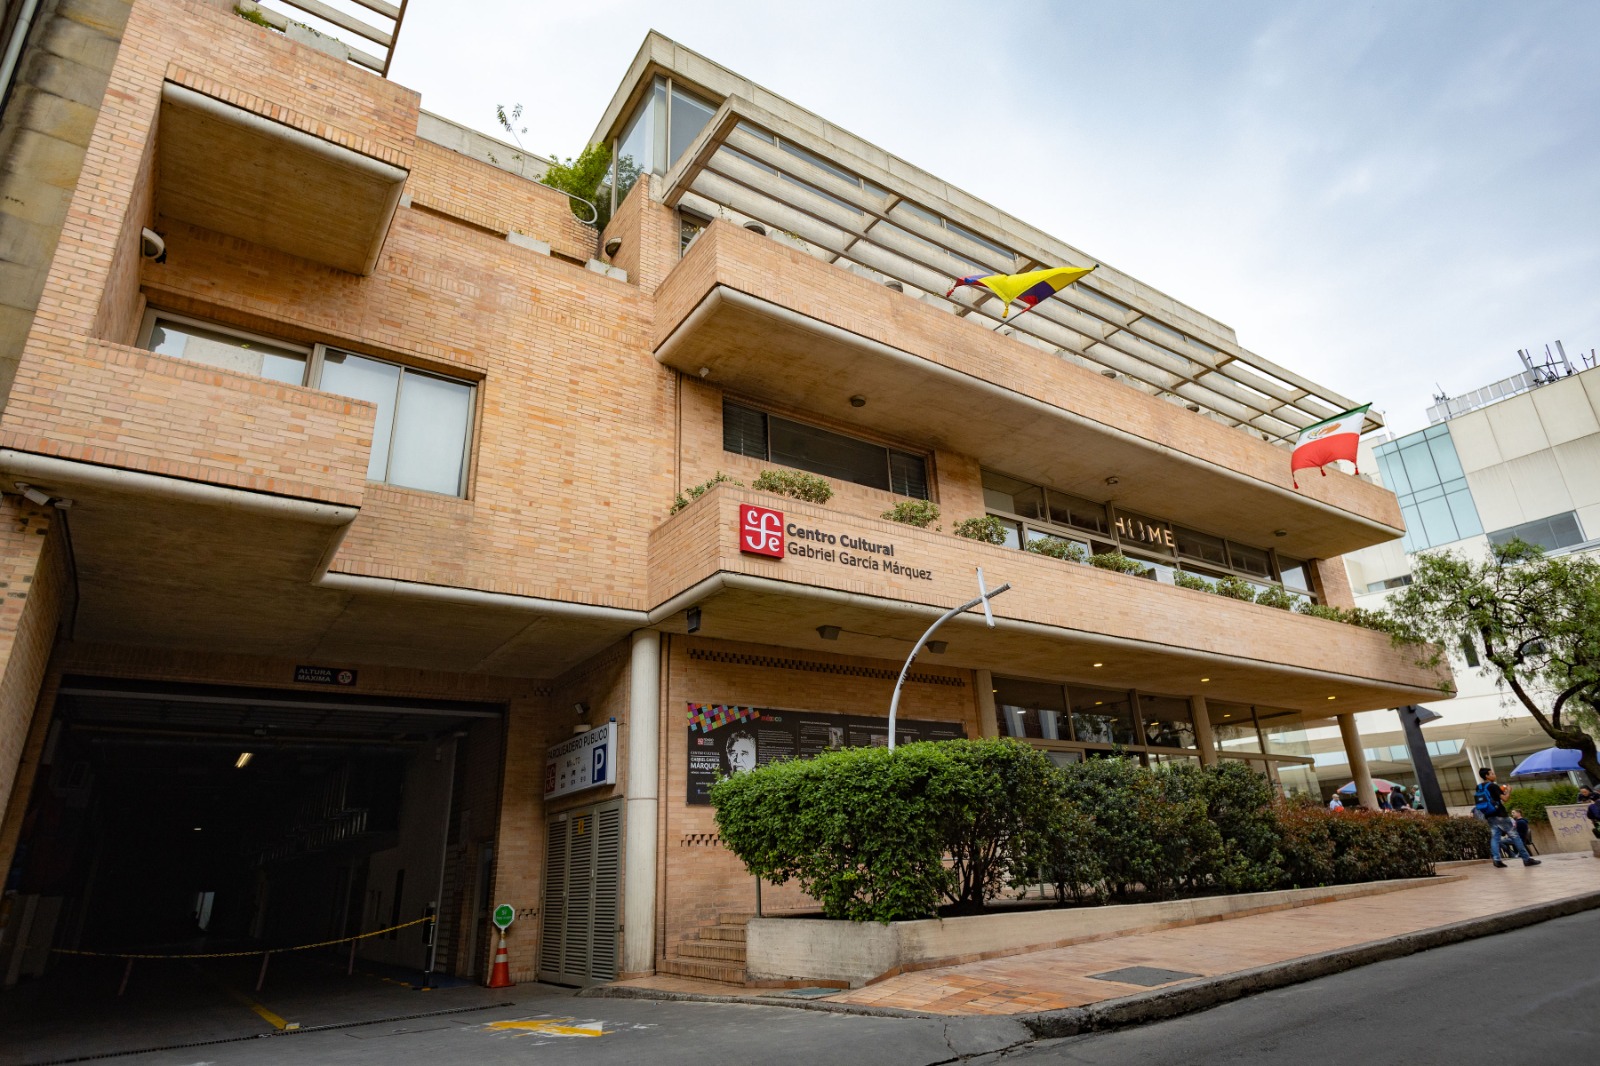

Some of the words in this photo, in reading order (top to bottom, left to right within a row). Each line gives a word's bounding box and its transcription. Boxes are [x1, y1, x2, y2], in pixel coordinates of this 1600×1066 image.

[786, 523, 837, 544] Centro
[839, 534, 895, 557] Cultural
[787, 542, 836, 563] Gabriel
[839, 551, 879, 571] García
[882, 559, 933, 581] Márquez
[297, 674, 331, 683] MAXIMA
[298, 668, 332, 676] ALTURA
[547, 738, 583, 759] PARQUEADERO
[594, 747, 605, 781] P
